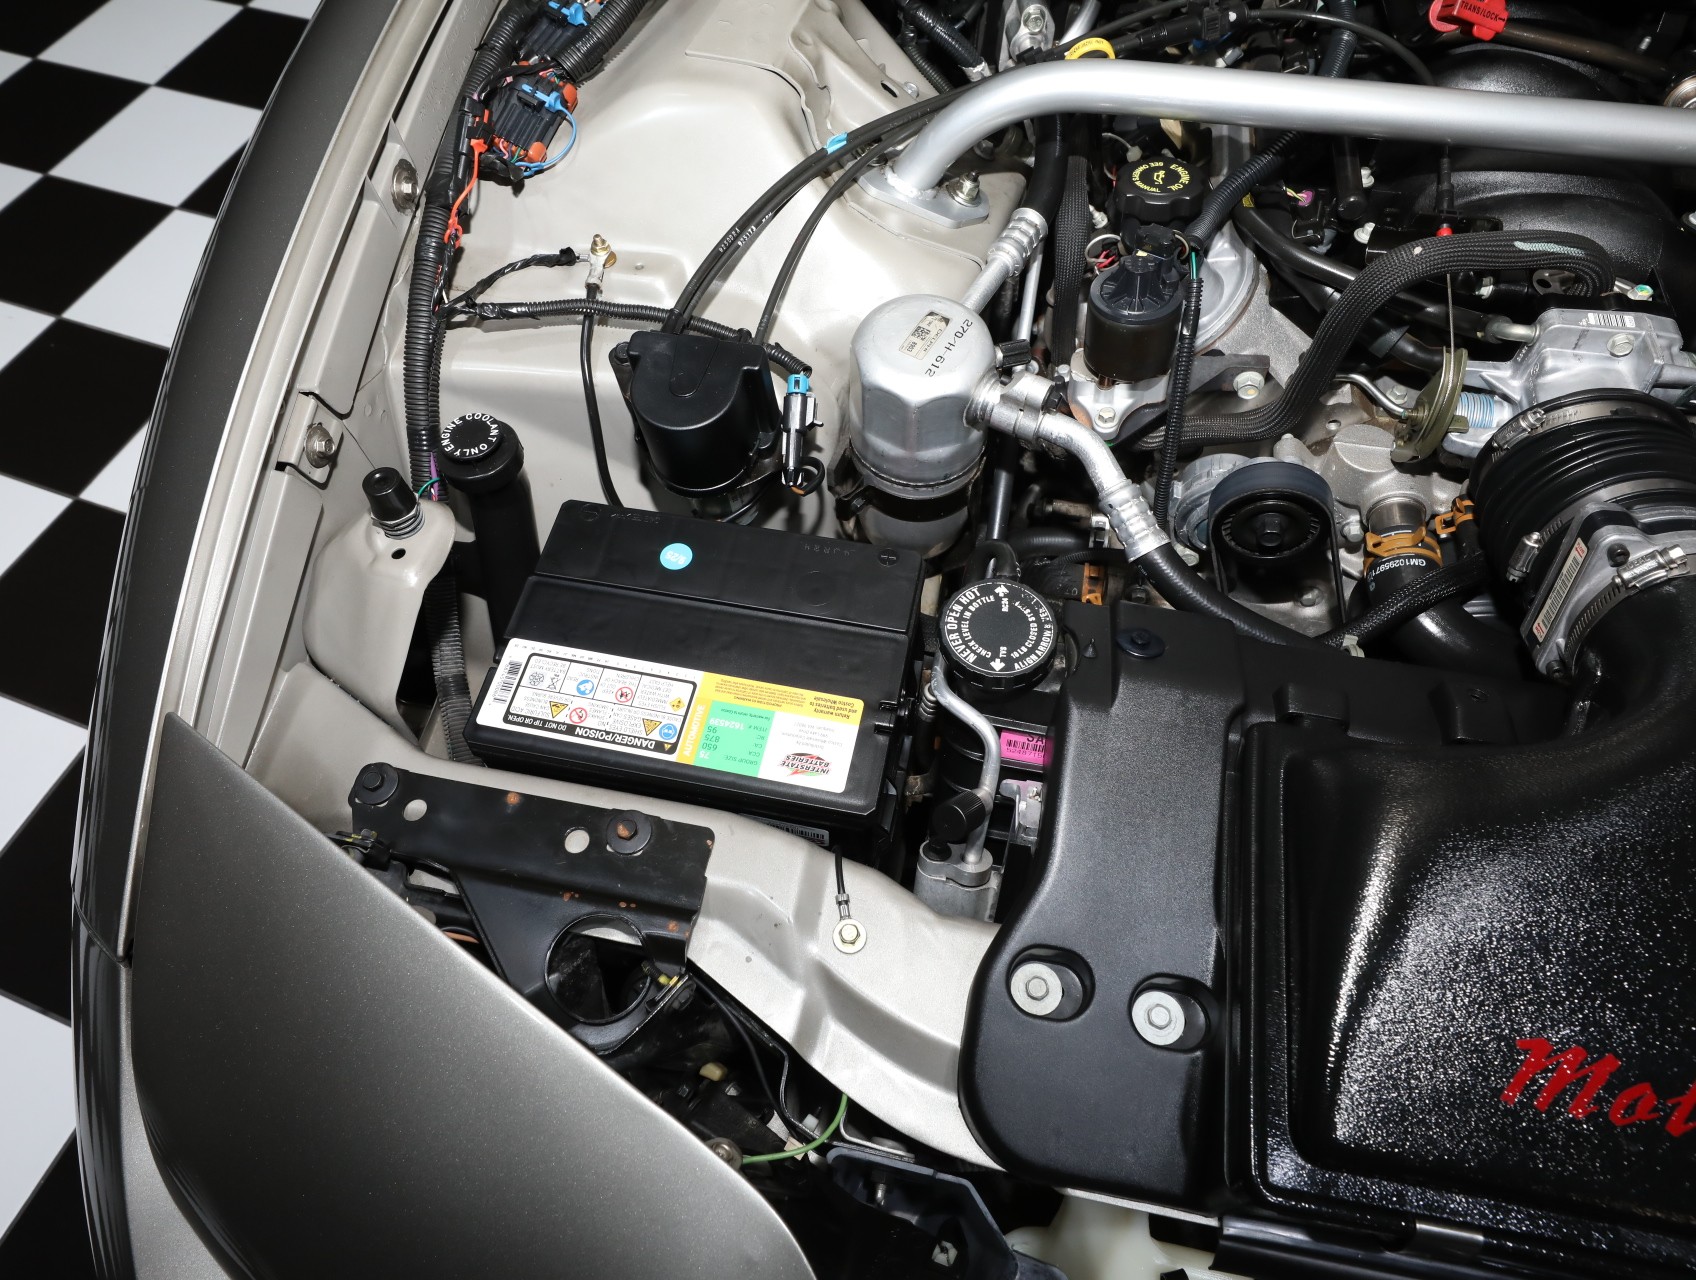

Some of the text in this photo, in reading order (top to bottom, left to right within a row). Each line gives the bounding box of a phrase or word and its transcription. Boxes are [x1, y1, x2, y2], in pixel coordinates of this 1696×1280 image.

[1166, 163, 1190, 191] ENGINE OIL
[1134, 180, 1160, 192] MANUAL
[440, 412, 499, 456] ENGINE COOLANT ONLY
[946, 587, 981, 663] NEVER OPEN HOT
[960, 594, 995, 658] CHECK LEVEL IN BOTTLE
[1010, 652, 1019, 660] 10
[1016, 643, 1027, 654] LB
[1024, 622, 1038, 650] CLOSED
[1013, 652, 1038, 670] ALIGN
[1037, 629, 1052, 655] ARROW
[812, 695, 837, 705] Wholesale
[814, 702, 836, 710] batteries
[836, 699, 855, 708] Costco
[506, 713, 524, 722] OPEN.
[812, 706, 850, 719] Return warranty
[543, 721, 557, 729] NOT
[706, 725, 718, 733] 95
[708, 717, 744, 729] 1624539
[681, 703, 706, 756] AUTOMOTIVE
[574, 725, 655, 749] DANGER/POISON
[703, 733, 721, 742] 875
[700, 741, 718, 751] 650
[698, 750, 711, 759] 75
[778, 759, 829, 775] INTERSTATE
[784, 754, 829, 768] BATTERIES
